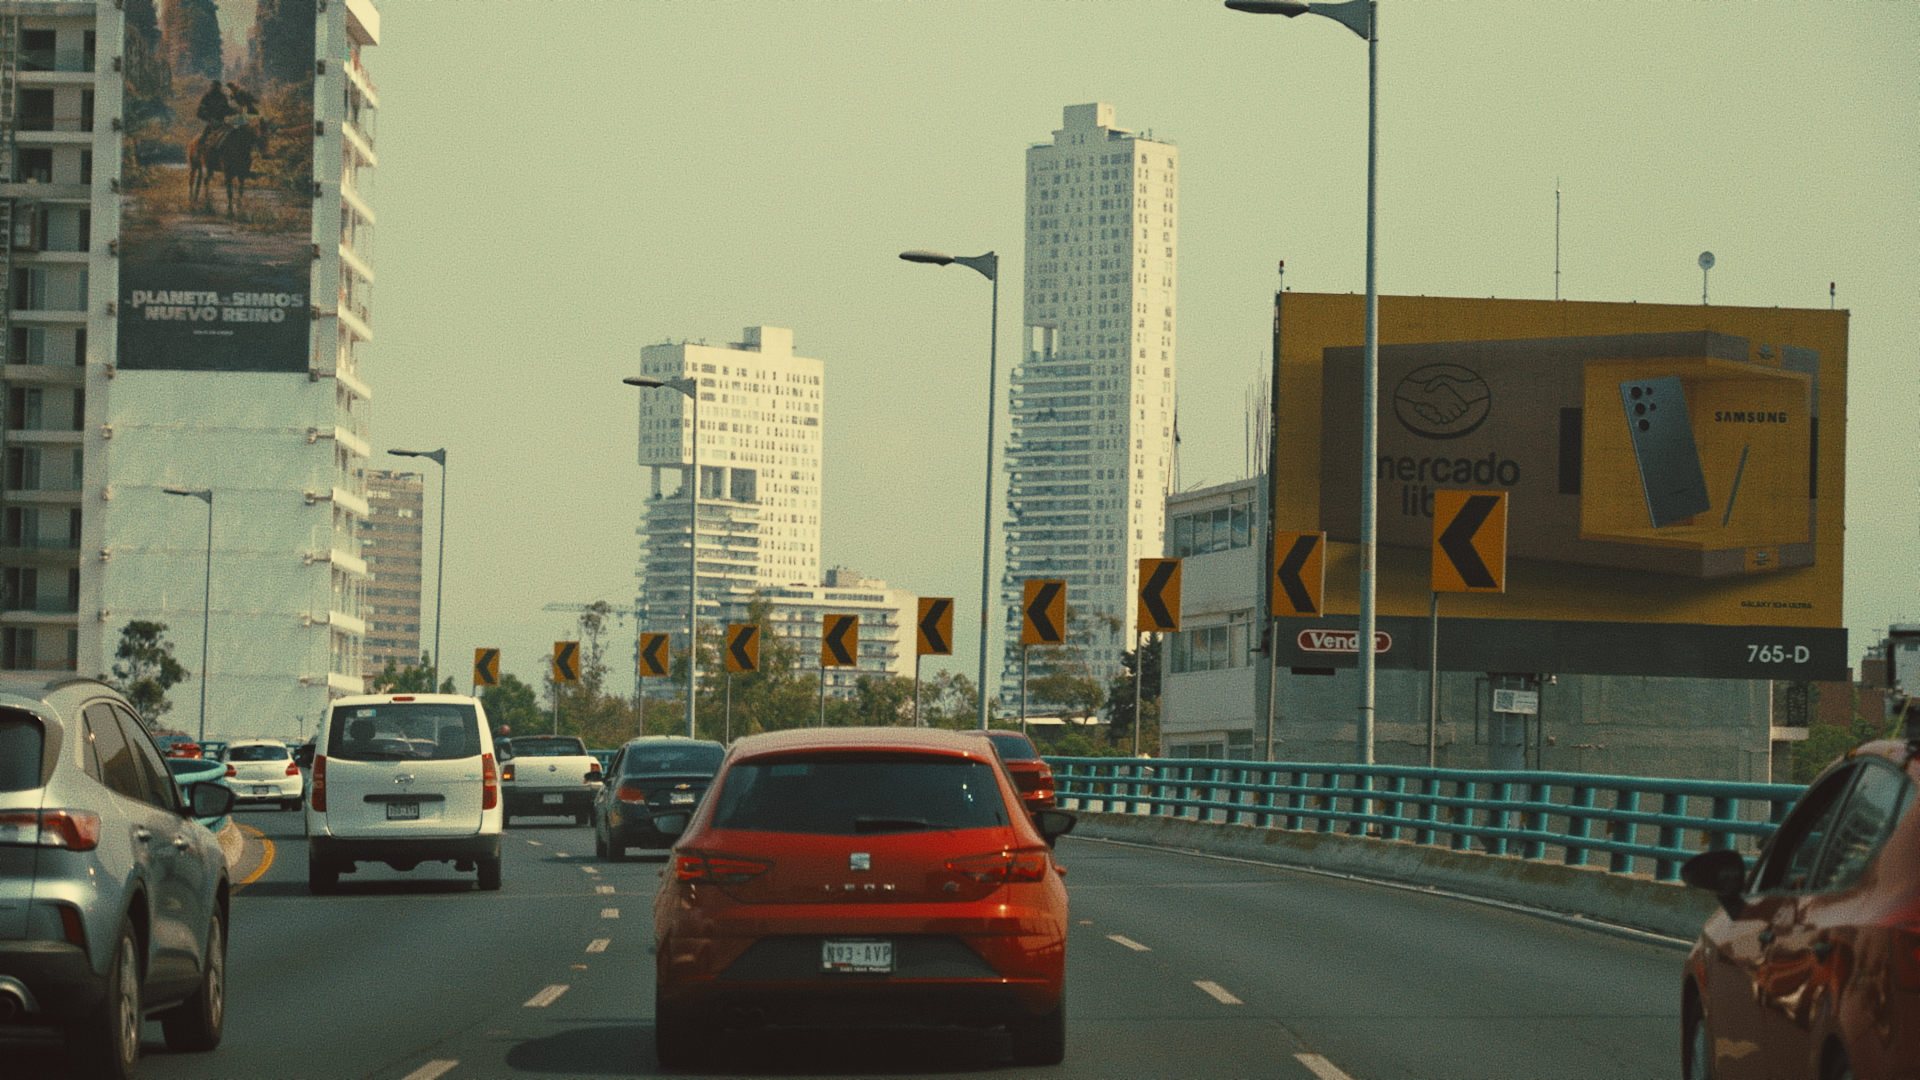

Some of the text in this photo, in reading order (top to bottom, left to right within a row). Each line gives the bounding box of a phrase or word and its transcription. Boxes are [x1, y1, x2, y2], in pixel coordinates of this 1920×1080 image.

[132, 290, 219, 309] PLANETA
[232, 292, 304, 308] SIMIOS
[145, 306, 286, 323] NUEVO REINO
[1715, 411, 1787, 423] SAMSUNG
[1309, 632, 1381, 650] Vendr
[1747, 645, 1810, 663] 765-D
